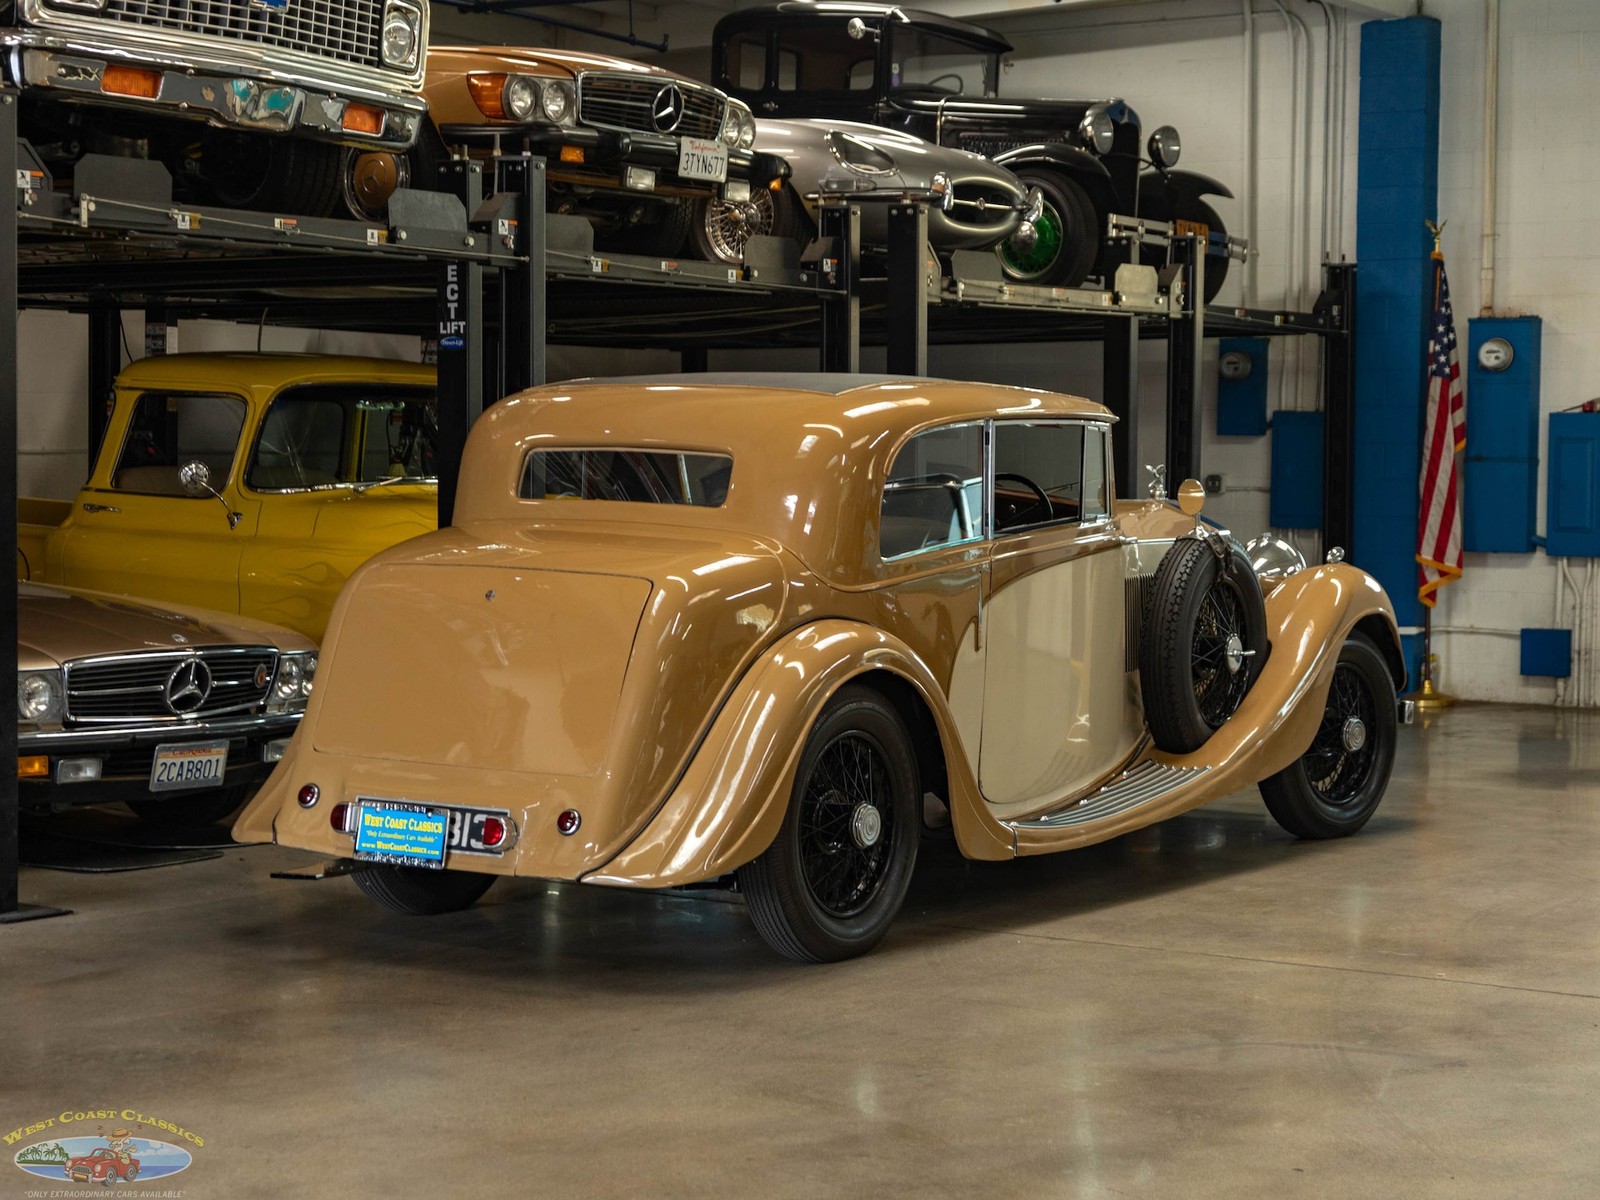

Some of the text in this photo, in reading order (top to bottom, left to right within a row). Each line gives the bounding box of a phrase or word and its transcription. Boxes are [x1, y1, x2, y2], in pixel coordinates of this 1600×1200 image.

[683, 152, 725, 176] 3TYN677
[446, 260, 459, 319] ECT
[440, 321, 466, 334] LIFT
[157, 758, 220, 783] 2CAB801
